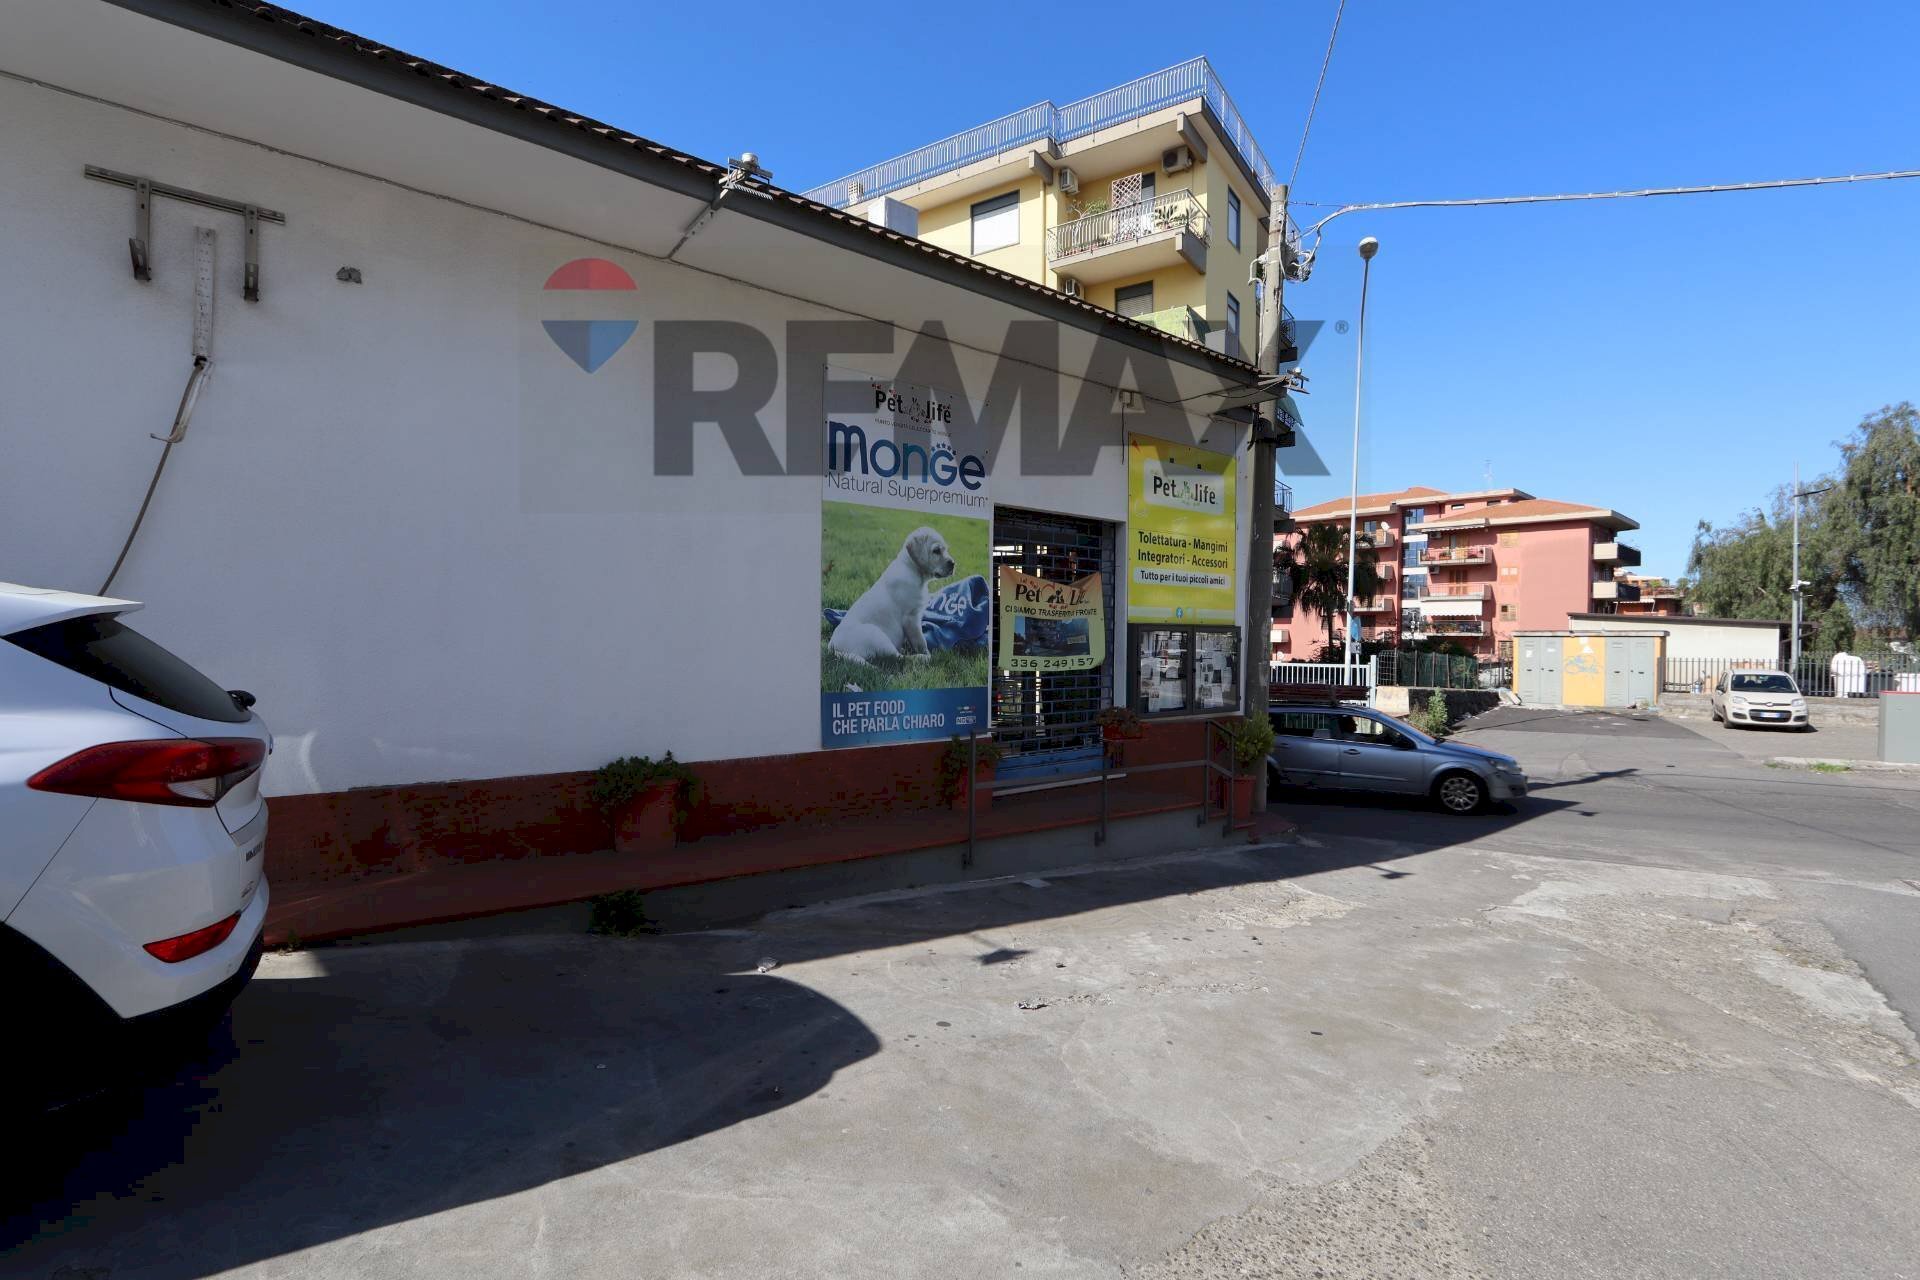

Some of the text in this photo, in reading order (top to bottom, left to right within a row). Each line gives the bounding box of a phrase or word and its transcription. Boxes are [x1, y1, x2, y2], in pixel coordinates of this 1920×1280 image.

[875, 390, 903, 414] Pet
[828, 472, 984, 507] Natural Superpremium
[1153, 475, 1216, 504] Pet life
[1138, 531, 1187, 548] Tolettatura
[1193, 538, 1228, 553] Mangimi
[1138, 549, 1185, 566] Integratori
[1192, 555, 1228, 569] Accessori
[1140, 570, 1159, 581] Tutto
[1160, 572, 1171, 584] per
[1175, 574, 1189, 584] tuoi
[1189, 576, 1209, 587] piccoli
[1210, 576, 1226, 586] amici
[1015, 584, 1042, 603] Pet
[1005, 605, 1012, 613] CI
[1013, 605, 1037, 616] SIAMO
[1010, 658, 1038, 668] 336
[832, 700, 906, 718] IL PET FOOD
[832, 718, 858, 735] CHE
[861, 715, 900, 732] PARLA
[902, 713, 945, 729] CHIARO
